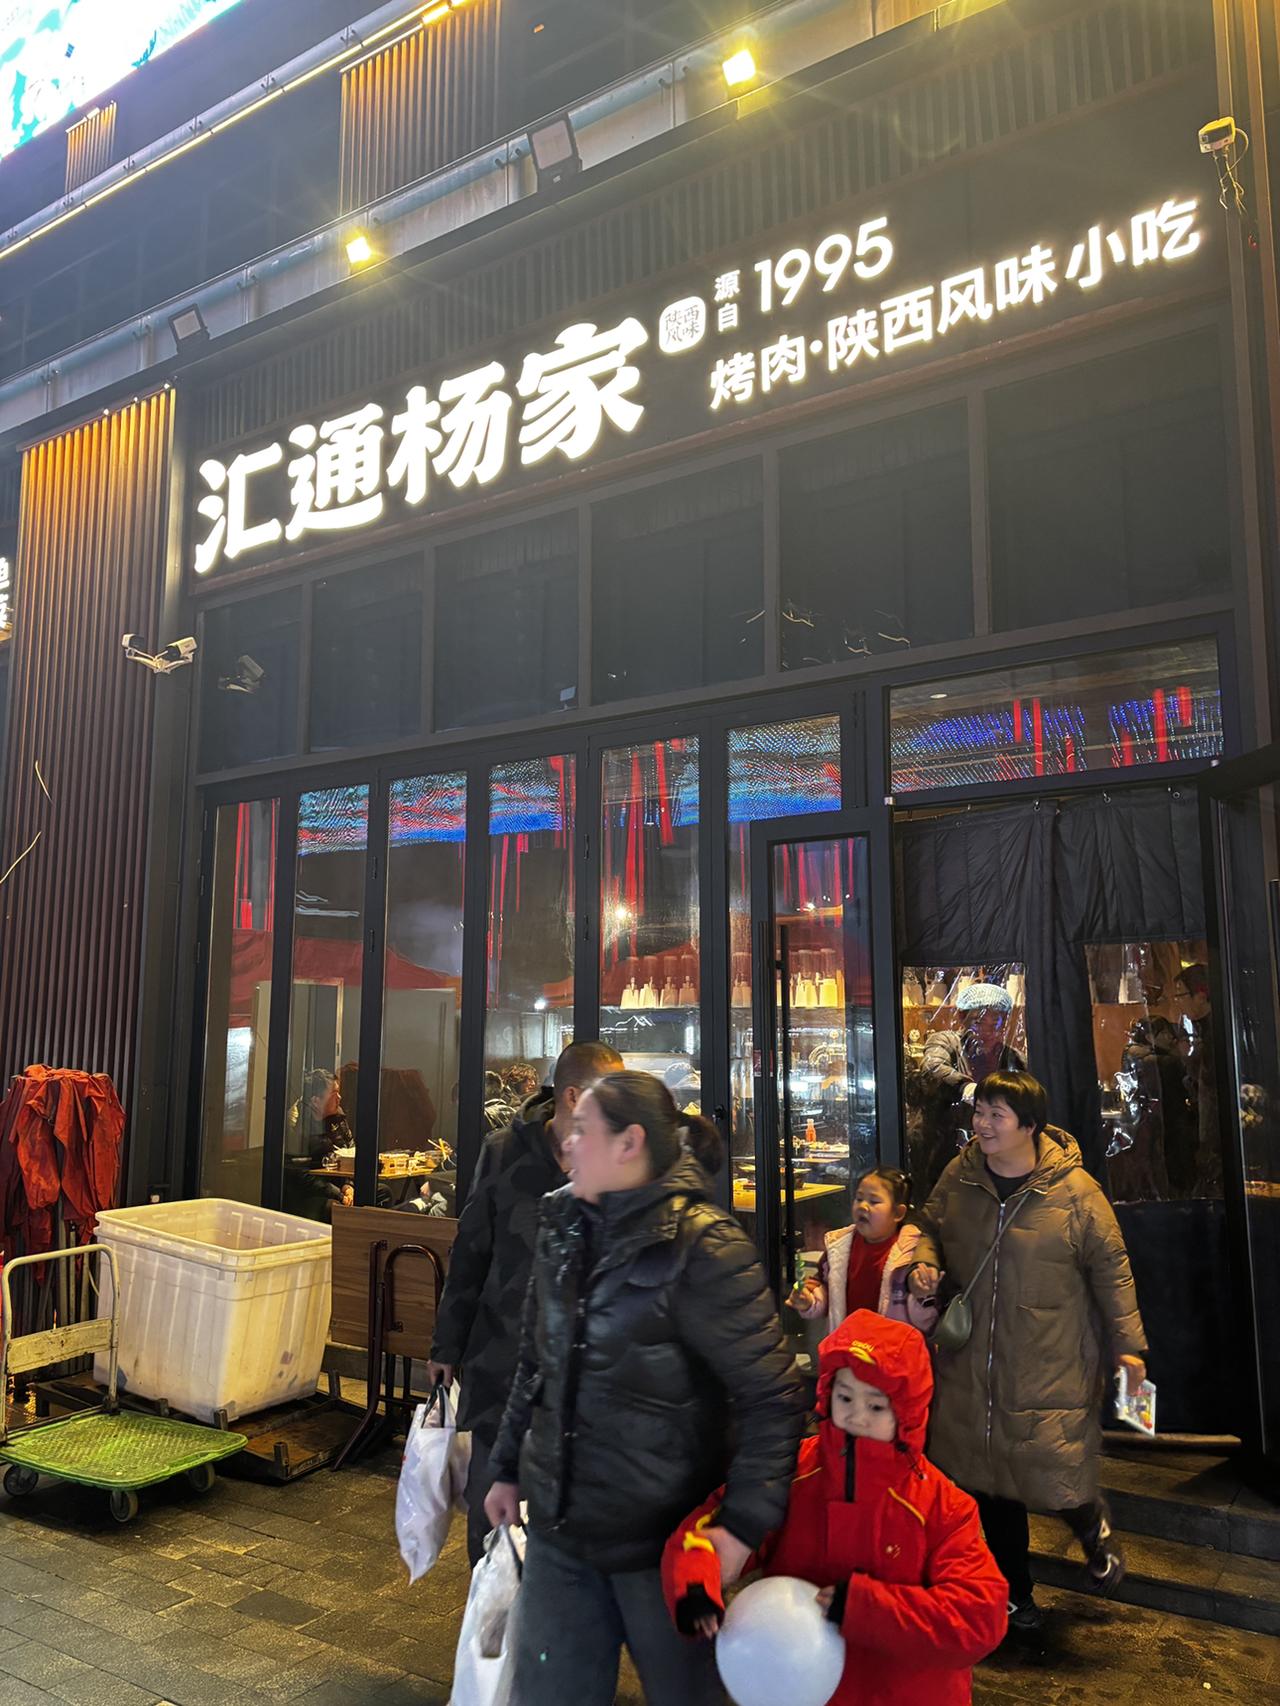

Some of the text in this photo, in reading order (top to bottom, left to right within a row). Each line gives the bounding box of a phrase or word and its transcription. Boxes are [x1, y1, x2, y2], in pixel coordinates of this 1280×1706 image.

[664, 304, 700, 331] 陕西
[710, 198, 1202, 410] 烤肉·陕西风味小吃
[713, 216, 894, 332] 源自 1995
[665, 321, 700, 346] 风味
[193, 316, 650, 574] 汇通杨家
